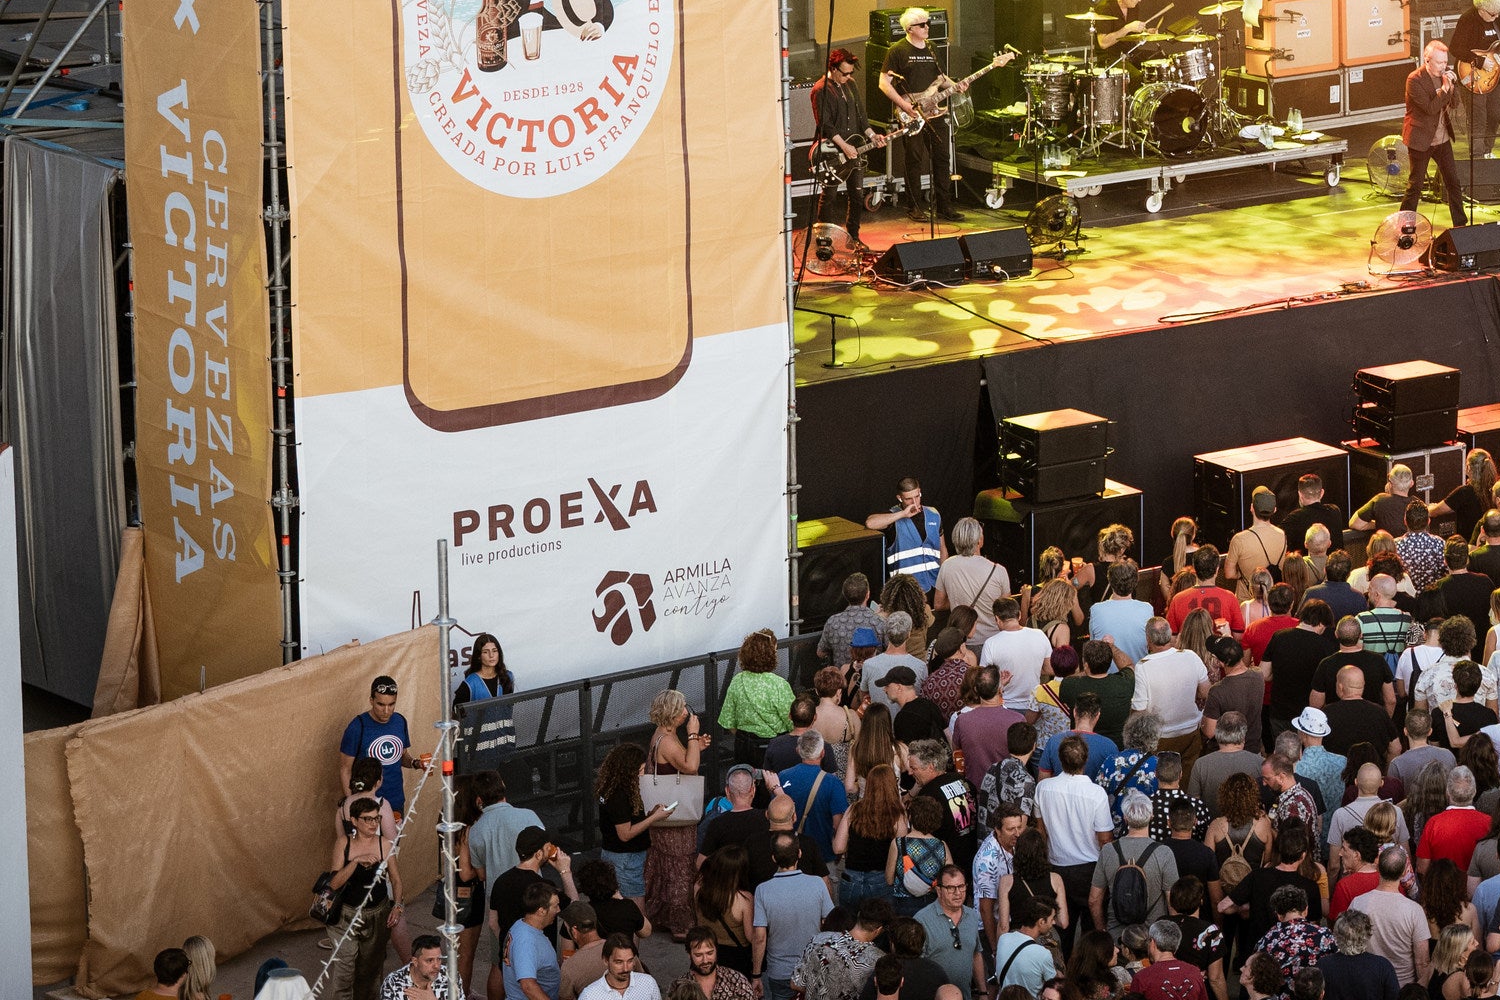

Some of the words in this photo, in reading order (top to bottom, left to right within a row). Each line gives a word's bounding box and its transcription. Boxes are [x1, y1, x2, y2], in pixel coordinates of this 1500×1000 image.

[428, 91, 485, 166] CREADA
[492, 156, 537, 176] POR
[545, 149, 596, 175] LUIS
[597, 21, 661, 152] FRANQUELO
[450, 52, 640, 153] VICTORIA
[503, 86, 550, 102] DESDE
[555, 82, 584, 95] 1928
[156, 79, 205, 583] VICTORIA
[201, 129, 236, 561] CERVEZAS
[453, 477, 658, 547] PROEXA
[461, 552, 484, 566] live
[488, 538, 562, 564] productions
[663, 557, 732, 585] ARMILLA
[662, 573, 732, 602] AVANZA
[663, 592, 731, 619] contigo
[381, 745, 394, 755] blur
